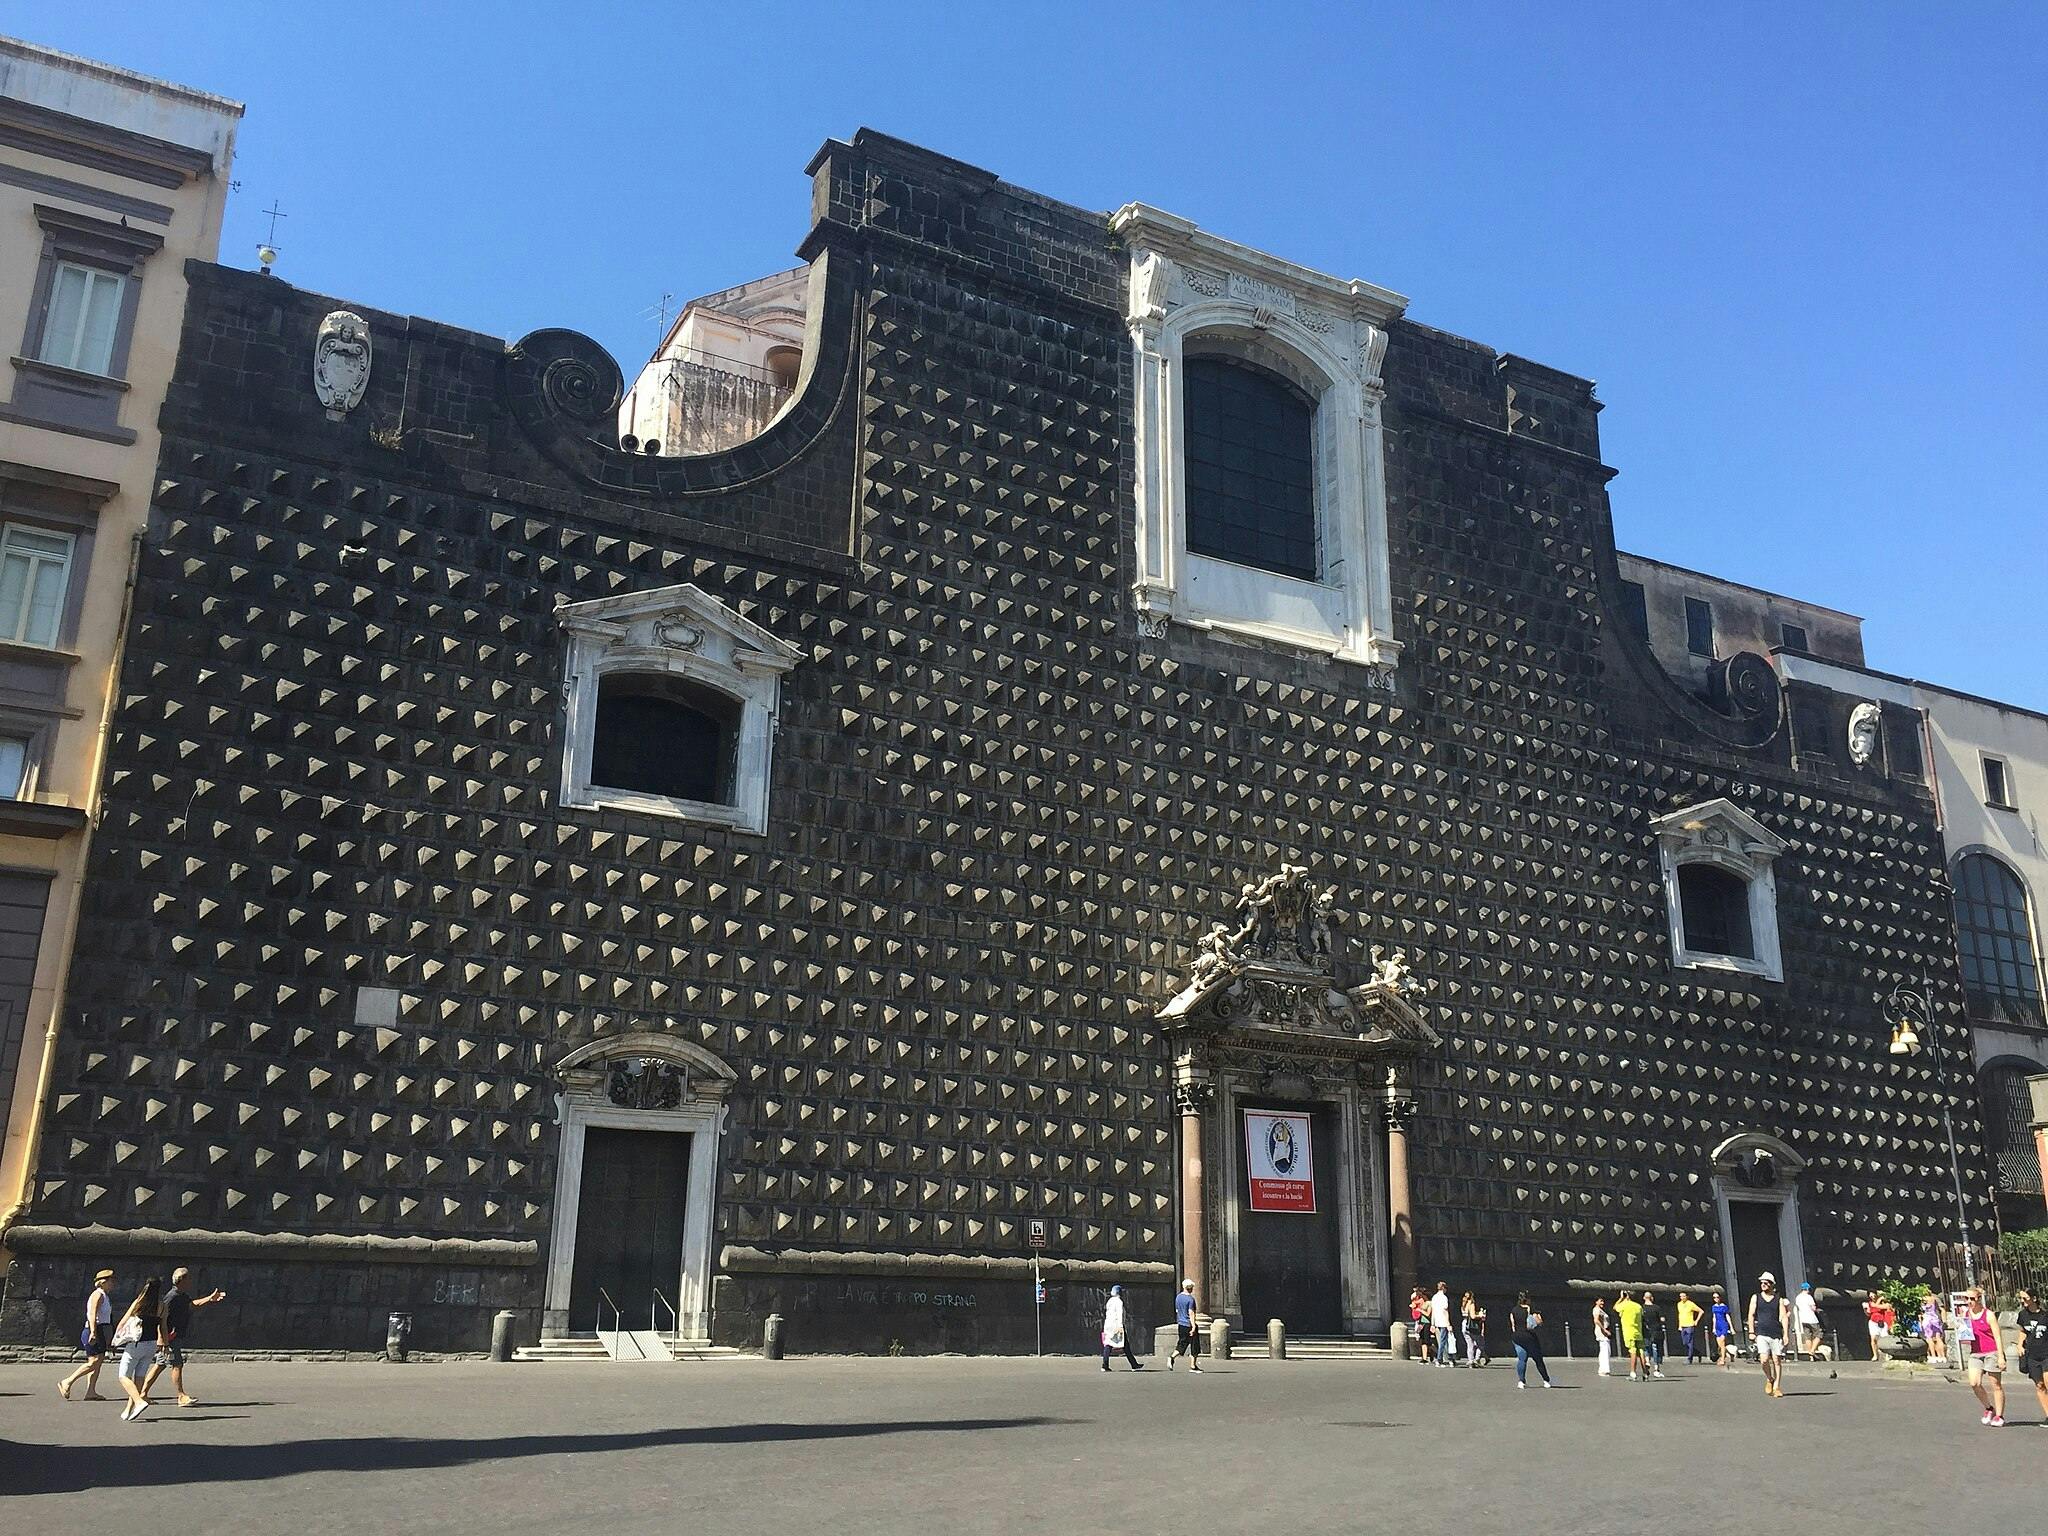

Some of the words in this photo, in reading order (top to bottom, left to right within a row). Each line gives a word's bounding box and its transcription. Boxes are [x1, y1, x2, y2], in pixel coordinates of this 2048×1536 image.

[1231, 273, 1251, 285] NON
[1251, 279, 1264, 291] EST
[931, 1294, 977, 1307] STRANA
